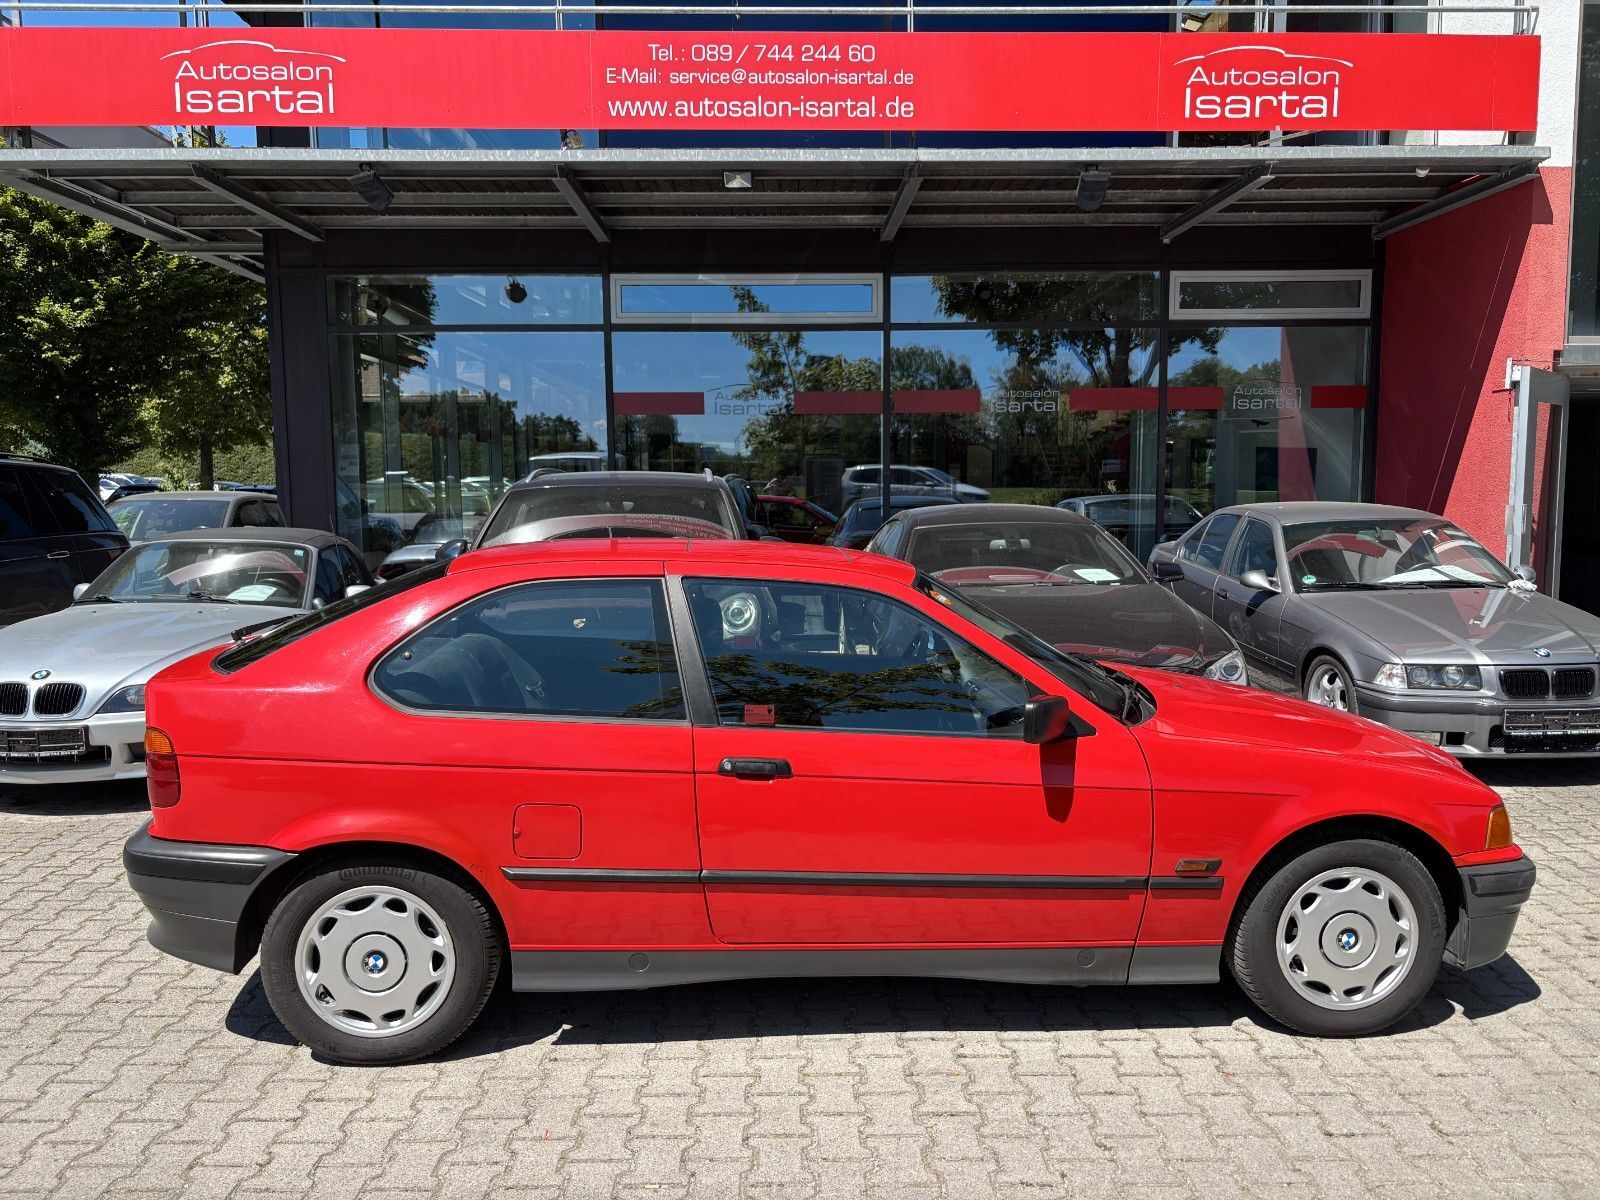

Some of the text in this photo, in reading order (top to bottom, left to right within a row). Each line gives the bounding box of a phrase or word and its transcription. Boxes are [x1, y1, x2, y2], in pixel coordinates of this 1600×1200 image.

[648, 44, 685, 62] Tel.:
[801, 44, 841, 62] 244
[848, 45, 876, 62] 60
[175, 60, 333, 81] Autosalon
[606, 67, 914, 85] E-Mail: service@autosalon-isartal.de
[1187, 66, 1339, 86] Autosalon
[174, 81, 334, 114] Isartal
[607, 95, 914, 118] www.autosalon-isartal.de
[1184, 86, 1339, 119] Isartal
[1233, 386, 1302, 396] Autosalon
[714, 401, 784, 415] Isarta
[1232, 395, 1302, 410] Isartal
